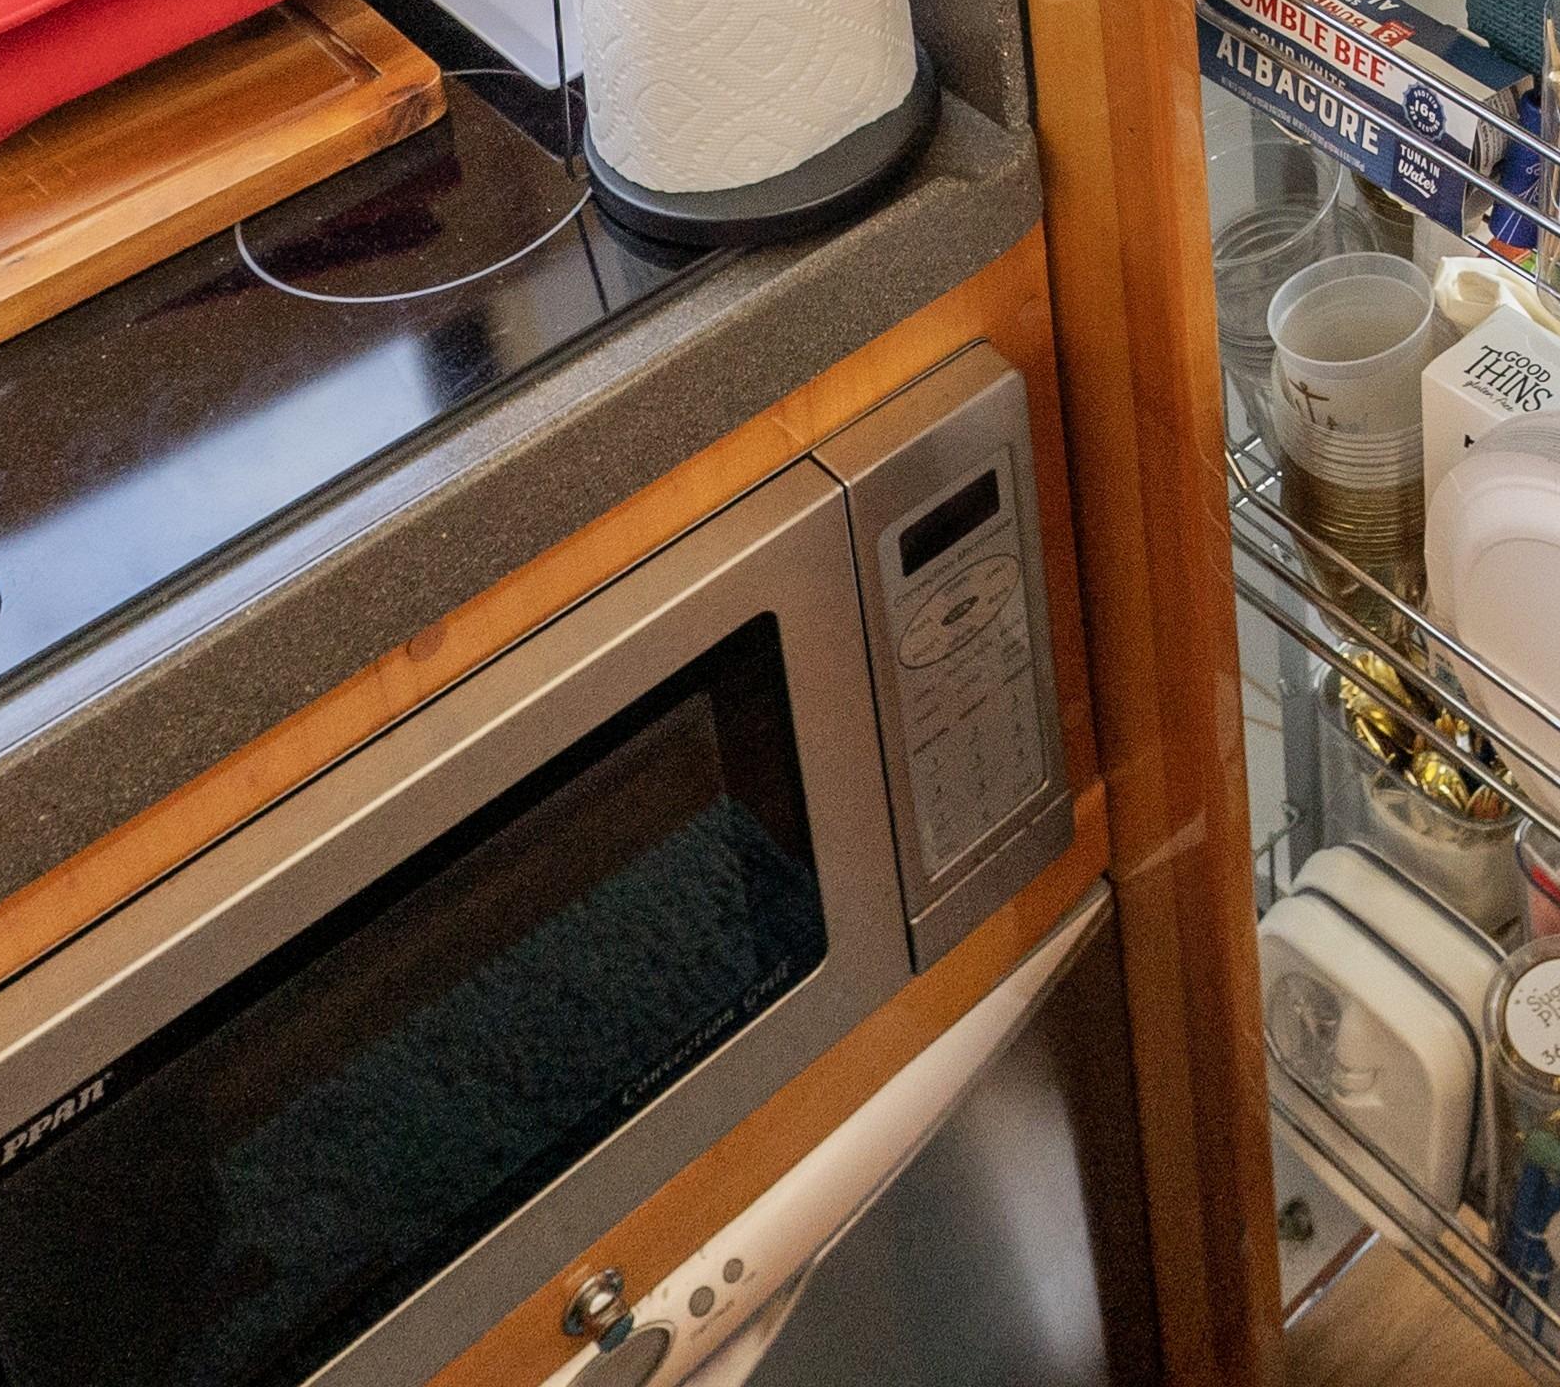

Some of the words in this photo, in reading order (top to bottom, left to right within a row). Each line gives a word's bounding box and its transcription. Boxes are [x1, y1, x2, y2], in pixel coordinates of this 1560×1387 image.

[1334, 34, 1388, 87] BEE
[1216, 31, 1380, 156] ALBACORE
[1413, 90, 1440, 110] PROTEIN
[1414, 100, 1438, 123] 16g
[1398, 159, 1438, 196] Water
[1400, 144, 1428, 169] TUNA
[1429, 160, 1440, 178] IN
[1463, 345, 1554, 413] THINS
[1503, 350, 1551, 383] GOOD
[1462, 379, 1494, 399] gluten
[1494, 395, 1514, 413] free
